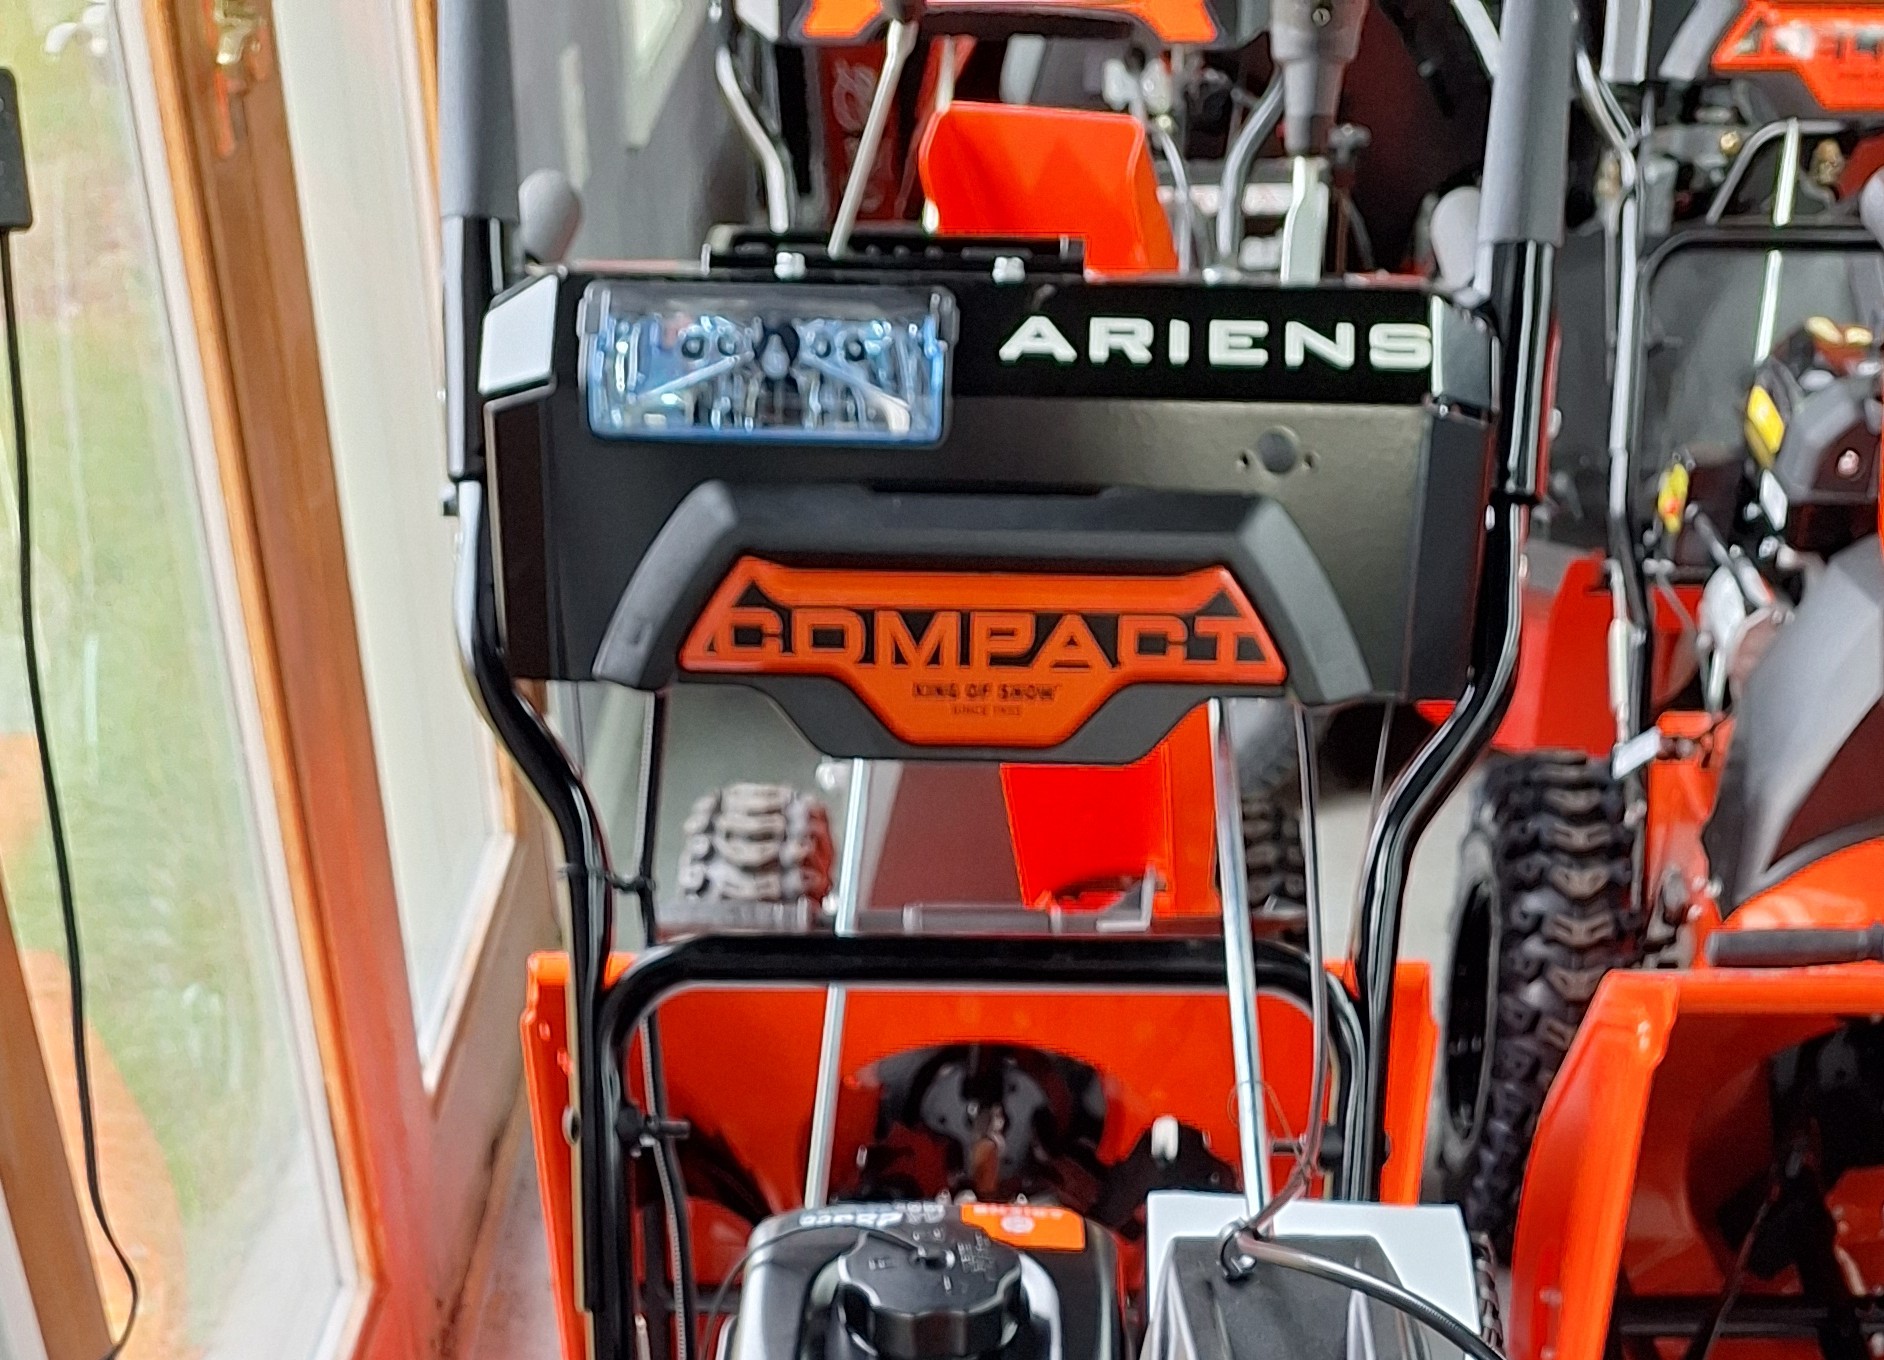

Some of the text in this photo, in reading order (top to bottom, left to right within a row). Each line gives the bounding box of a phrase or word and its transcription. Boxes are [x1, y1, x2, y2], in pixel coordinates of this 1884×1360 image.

[999, 315, 1431, 370] ARIENS
[707, 606, 1270, 669] COMPACT
[965, 682, 992, 700] OF
